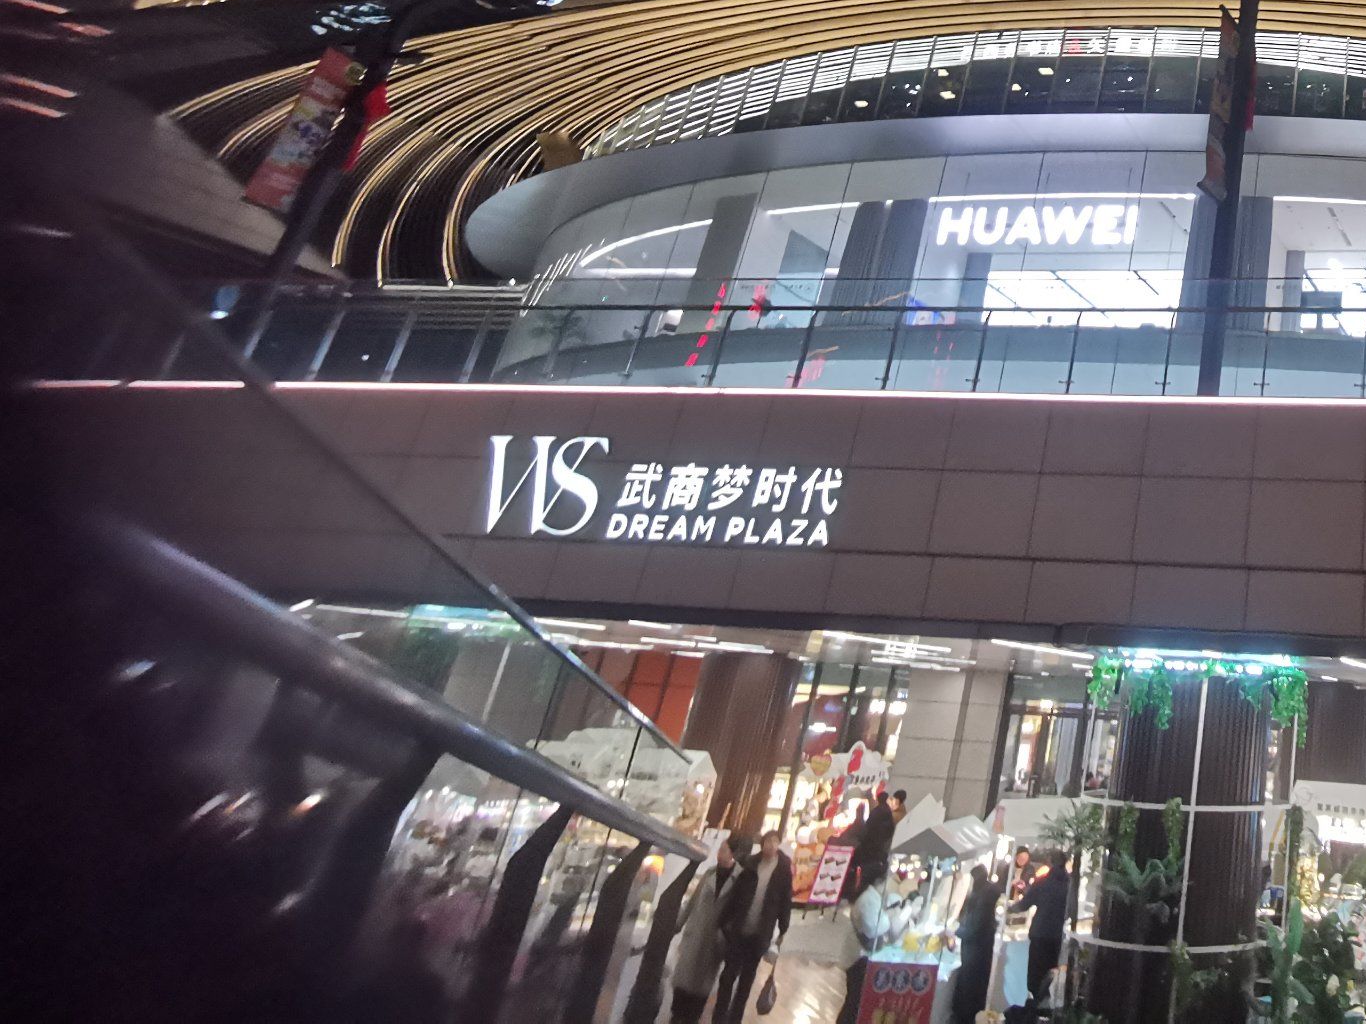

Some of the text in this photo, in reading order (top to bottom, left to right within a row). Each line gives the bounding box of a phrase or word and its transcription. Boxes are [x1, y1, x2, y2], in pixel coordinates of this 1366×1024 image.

[936, 204, 1139, 246] HUAWEI
[616, 462, 843, 515] 武商梦时代
[606, 513, 830, 546] DREAM PLAZA
